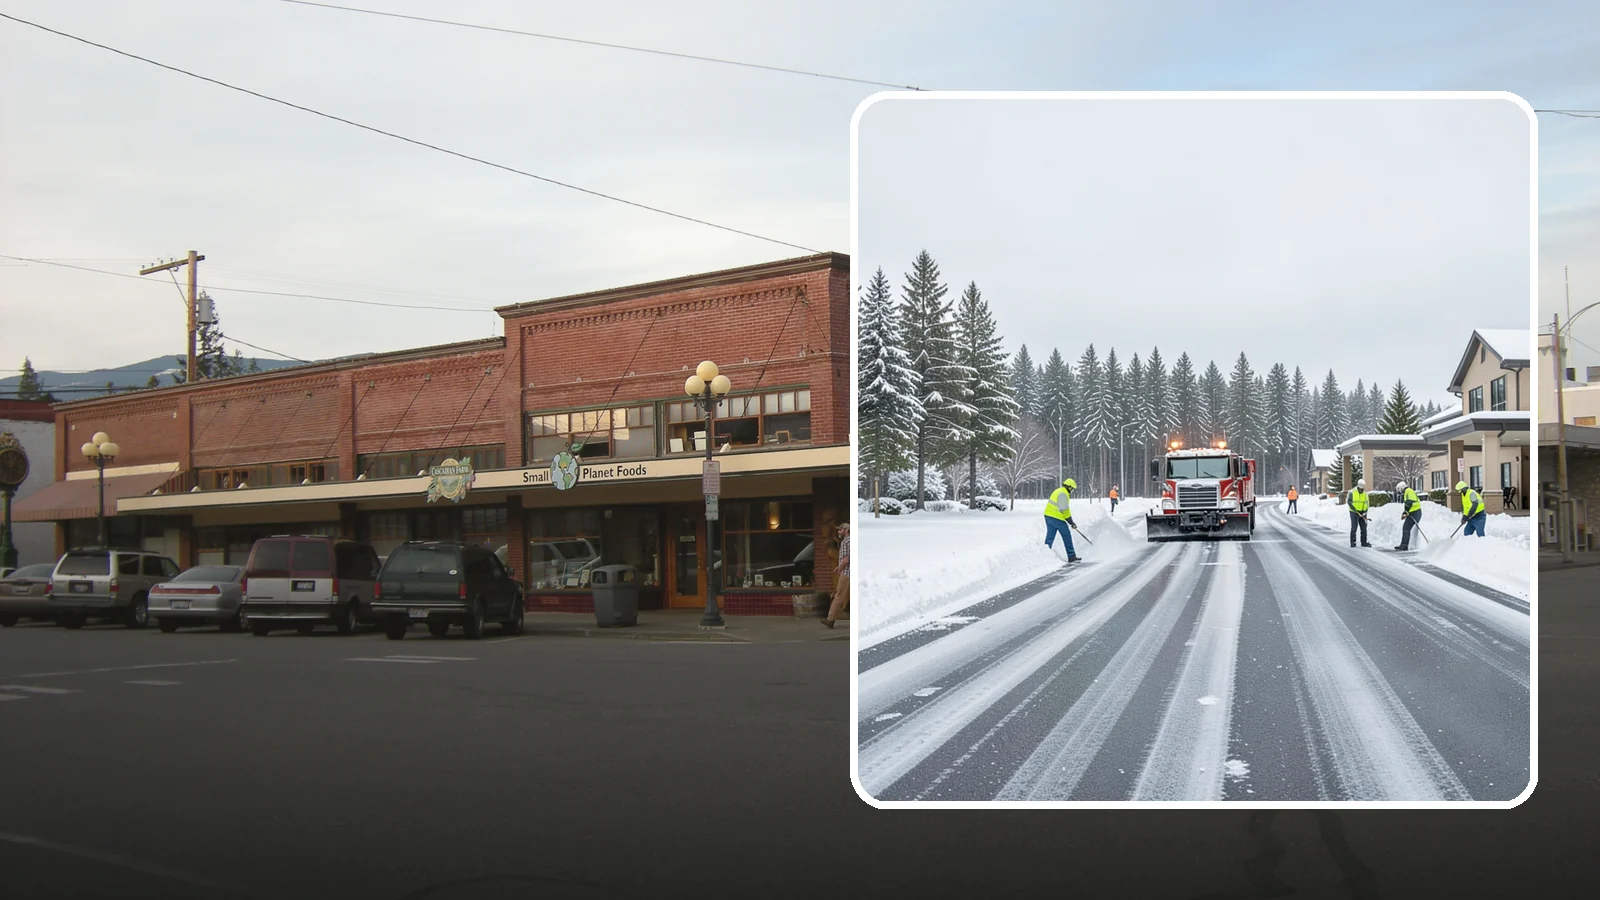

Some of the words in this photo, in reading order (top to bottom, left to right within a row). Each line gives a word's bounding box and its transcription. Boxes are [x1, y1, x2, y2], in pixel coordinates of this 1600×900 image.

[523, 470, 549, 483] Small
[583, 467, 614, 479] Planet
[617, 464, 647, 476] Foods
